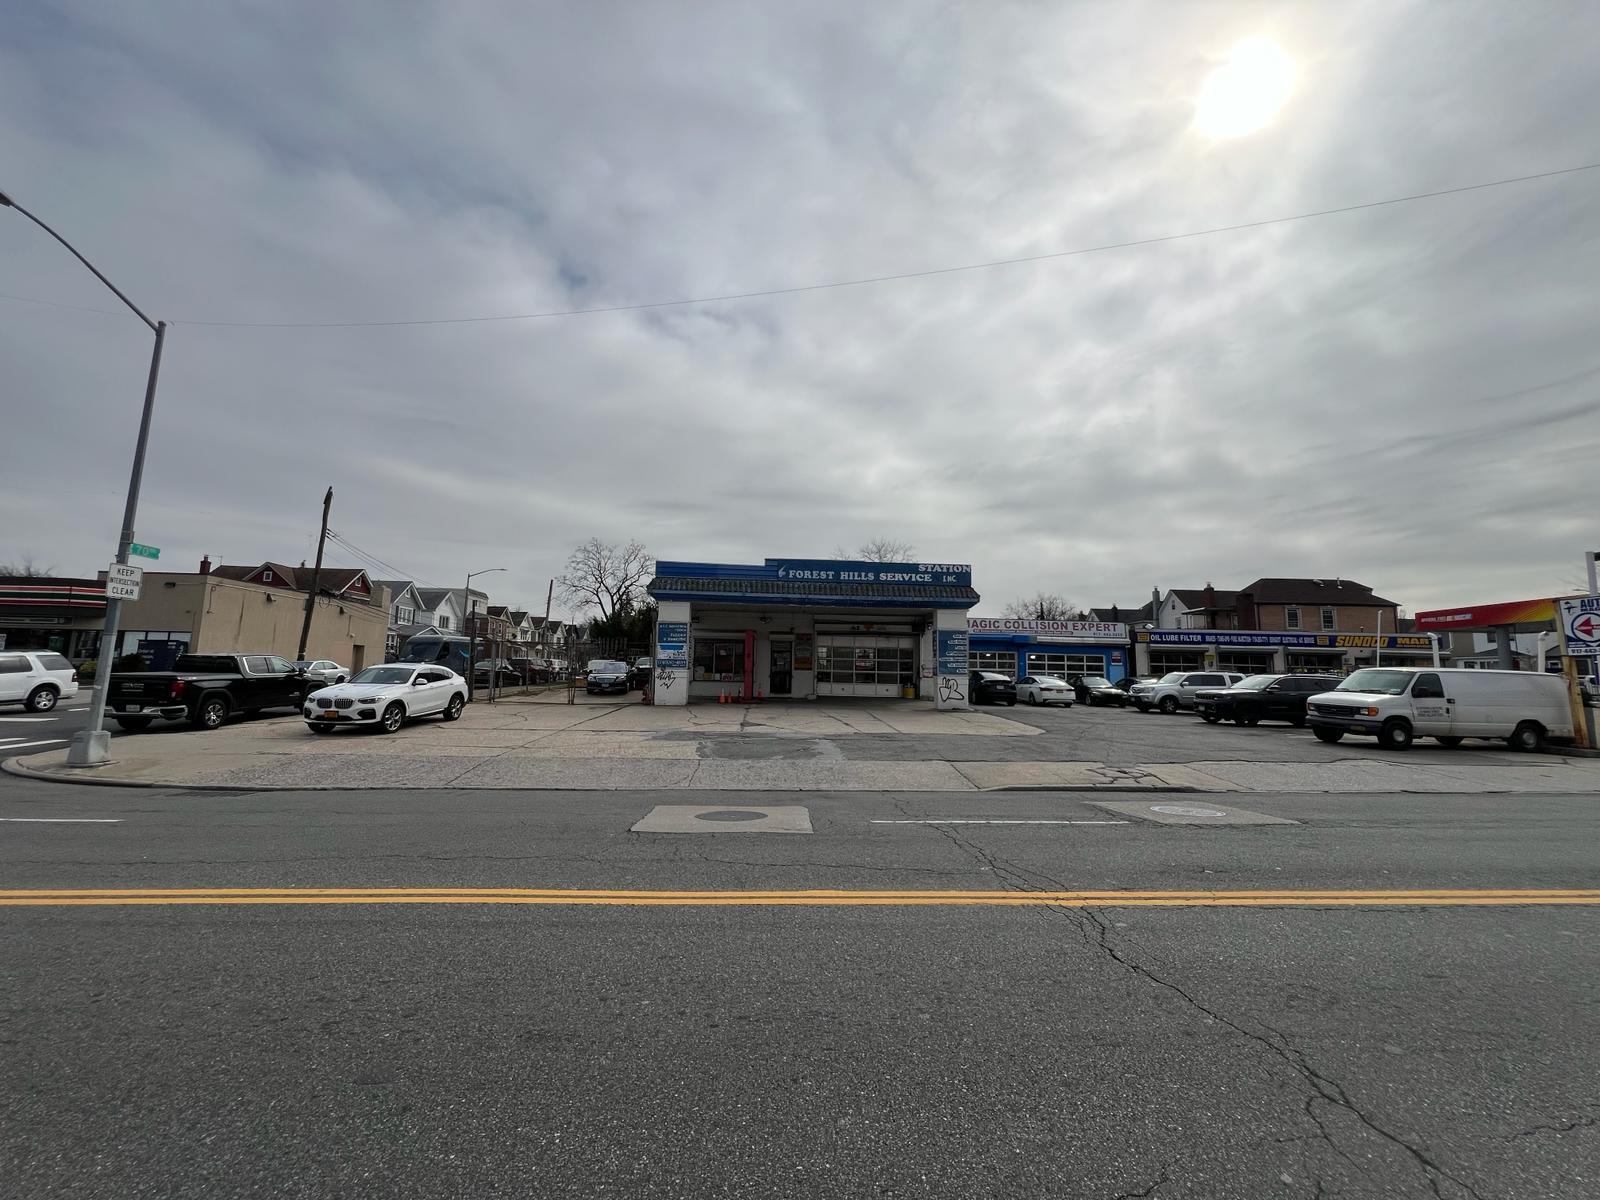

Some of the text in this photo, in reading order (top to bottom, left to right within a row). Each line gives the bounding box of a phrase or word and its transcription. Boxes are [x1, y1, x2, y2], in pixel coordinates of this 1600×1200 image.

[117, 568, 135, 577] KEEP
[918, 564, 971, 573] STATION
[788, 569, 957, 583] FOREST HILLS SERVICE INC
[110, 577, 140, 587] INTERSECTION
[112, 586, 135, 597] CLEAR
[1004, 620, 1069, 631] COLLISION
[1072, 622, 1118, 632] EXPERT
[1150, 634, 1162, 642] OIL
[1162, 634, 1179, 642] LUBE
[1180, 634, 1202, 642] FILTER
[1335, 635, 1389, 648] SUNOCO
